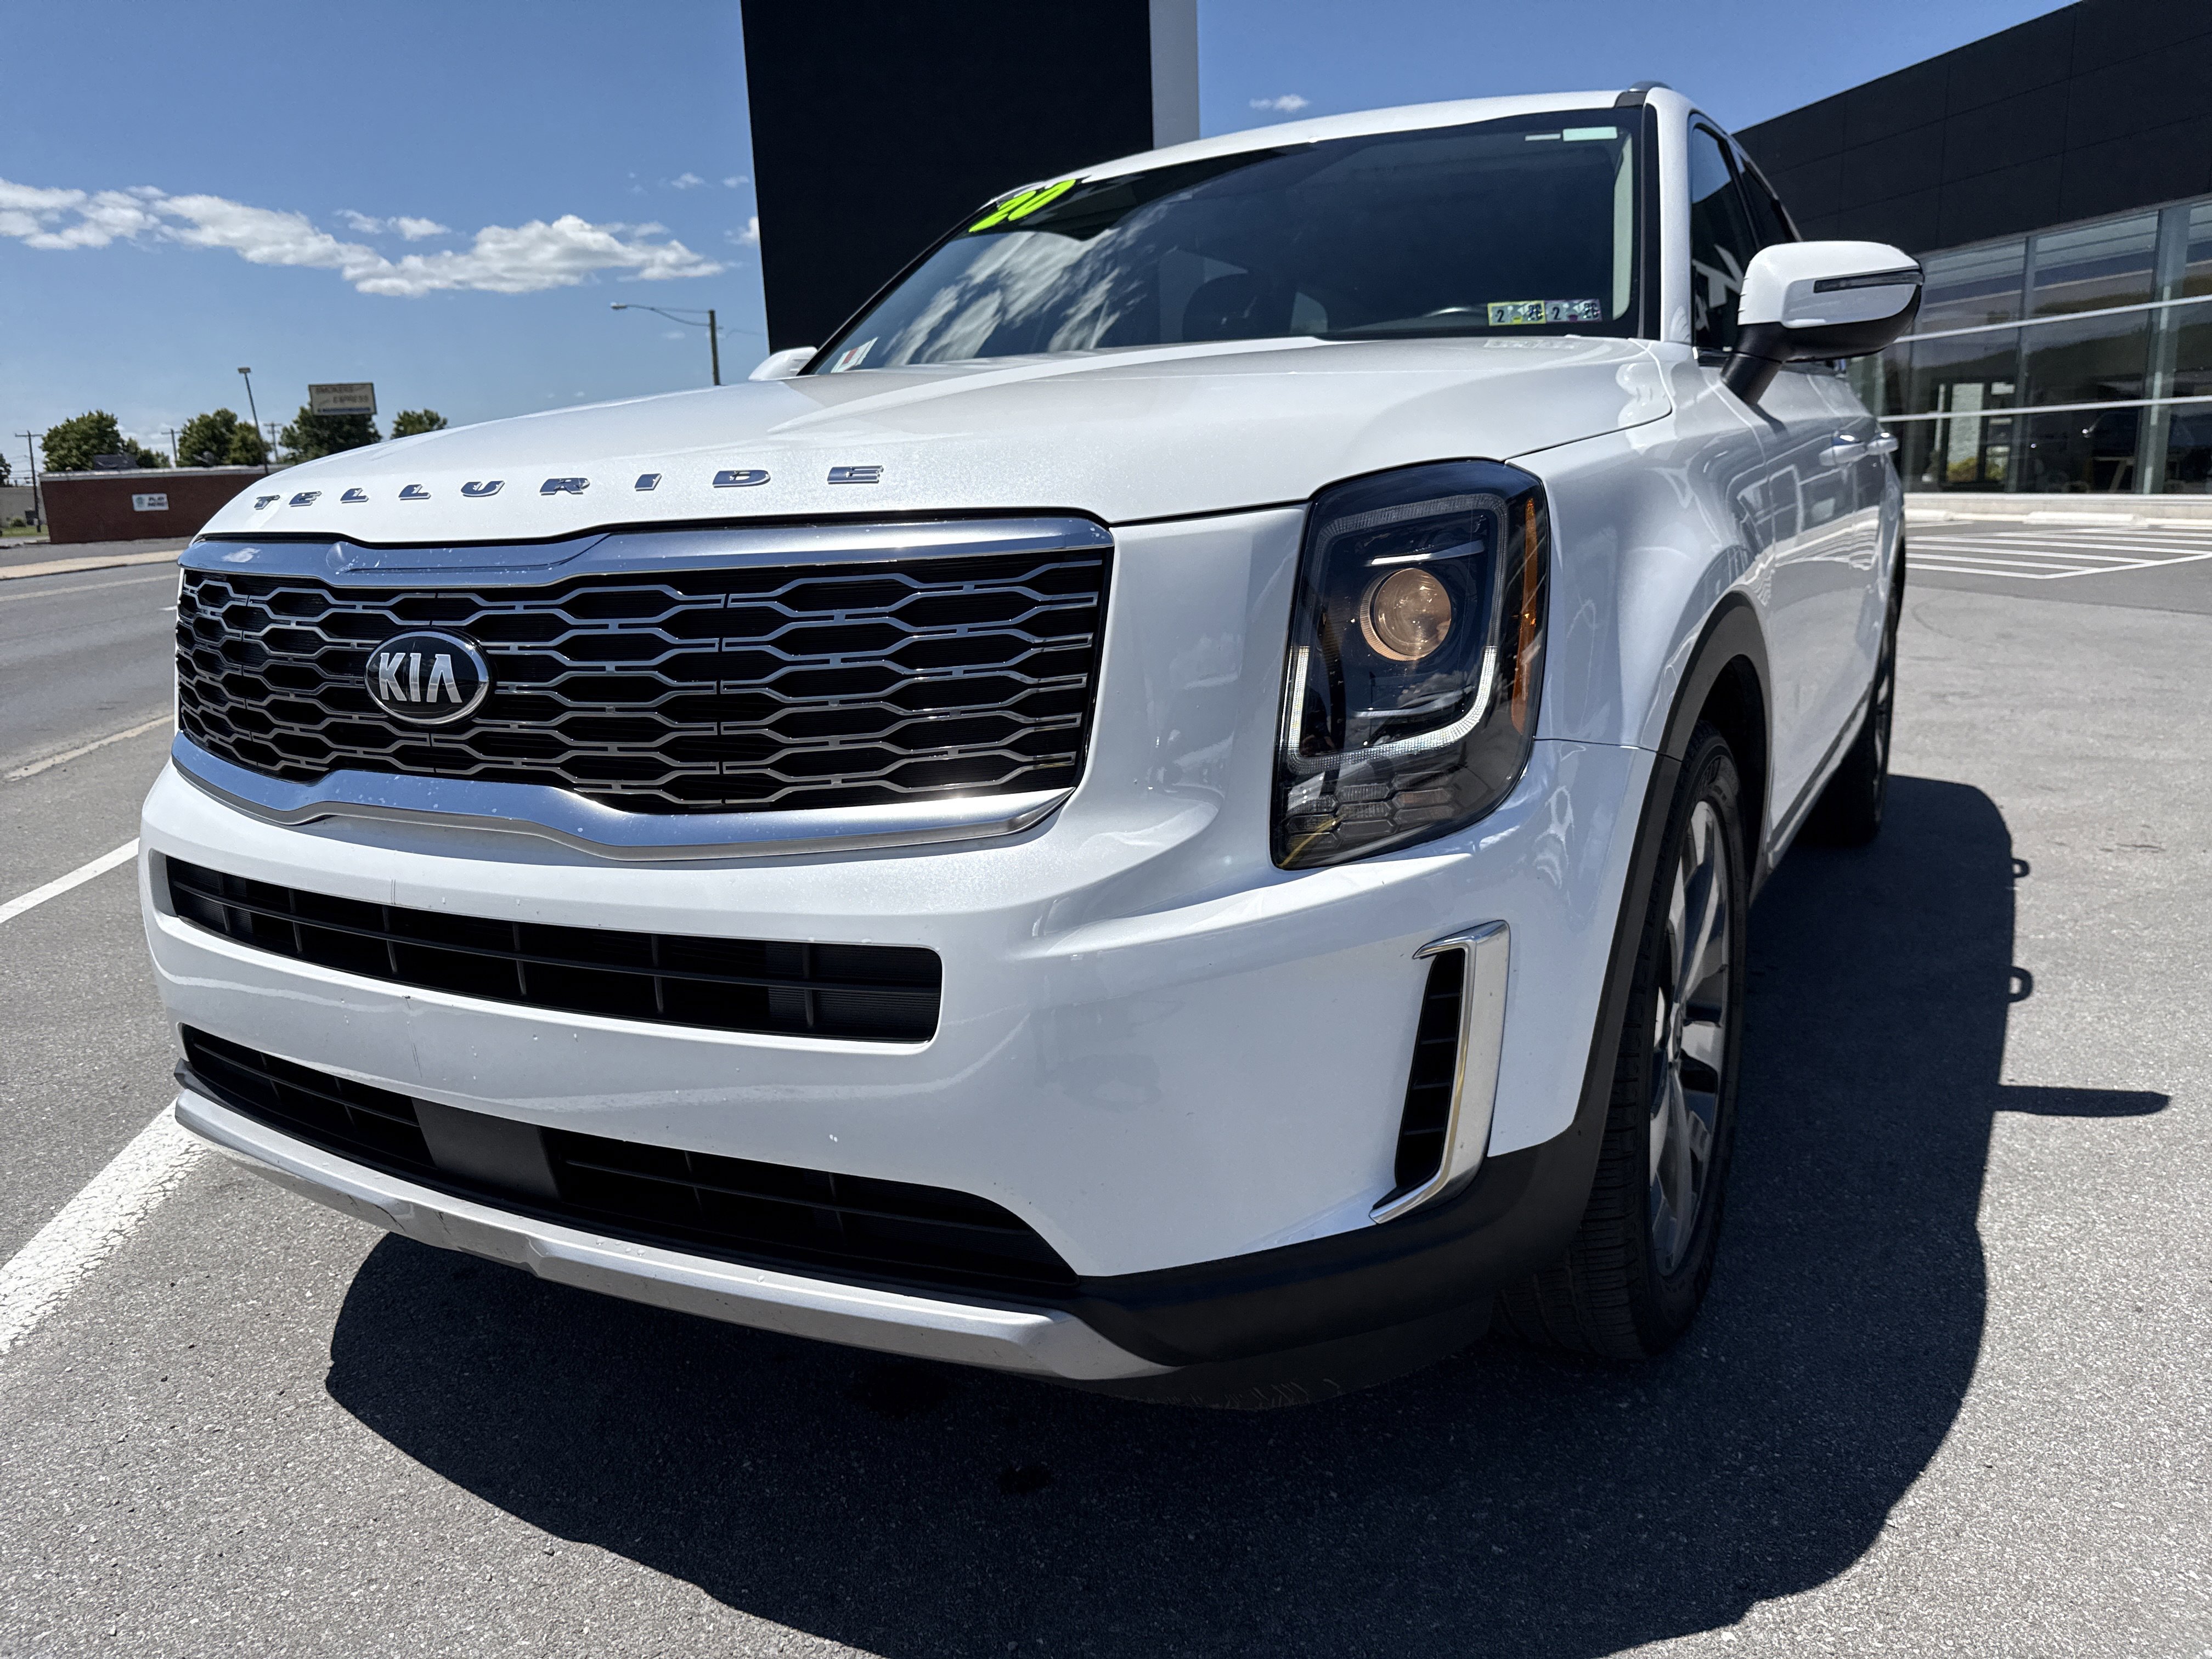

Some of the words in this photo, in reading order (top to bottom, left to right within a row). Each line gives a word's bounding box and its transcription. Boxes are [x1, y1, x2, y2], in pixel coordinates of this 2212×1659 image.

[1496, 309, 1505, 323] 2
[1551, 306, 1561, 320] 2
[253, 465, 883, 510] TELLURIDE
[379, 652, 463, 703] KIA
